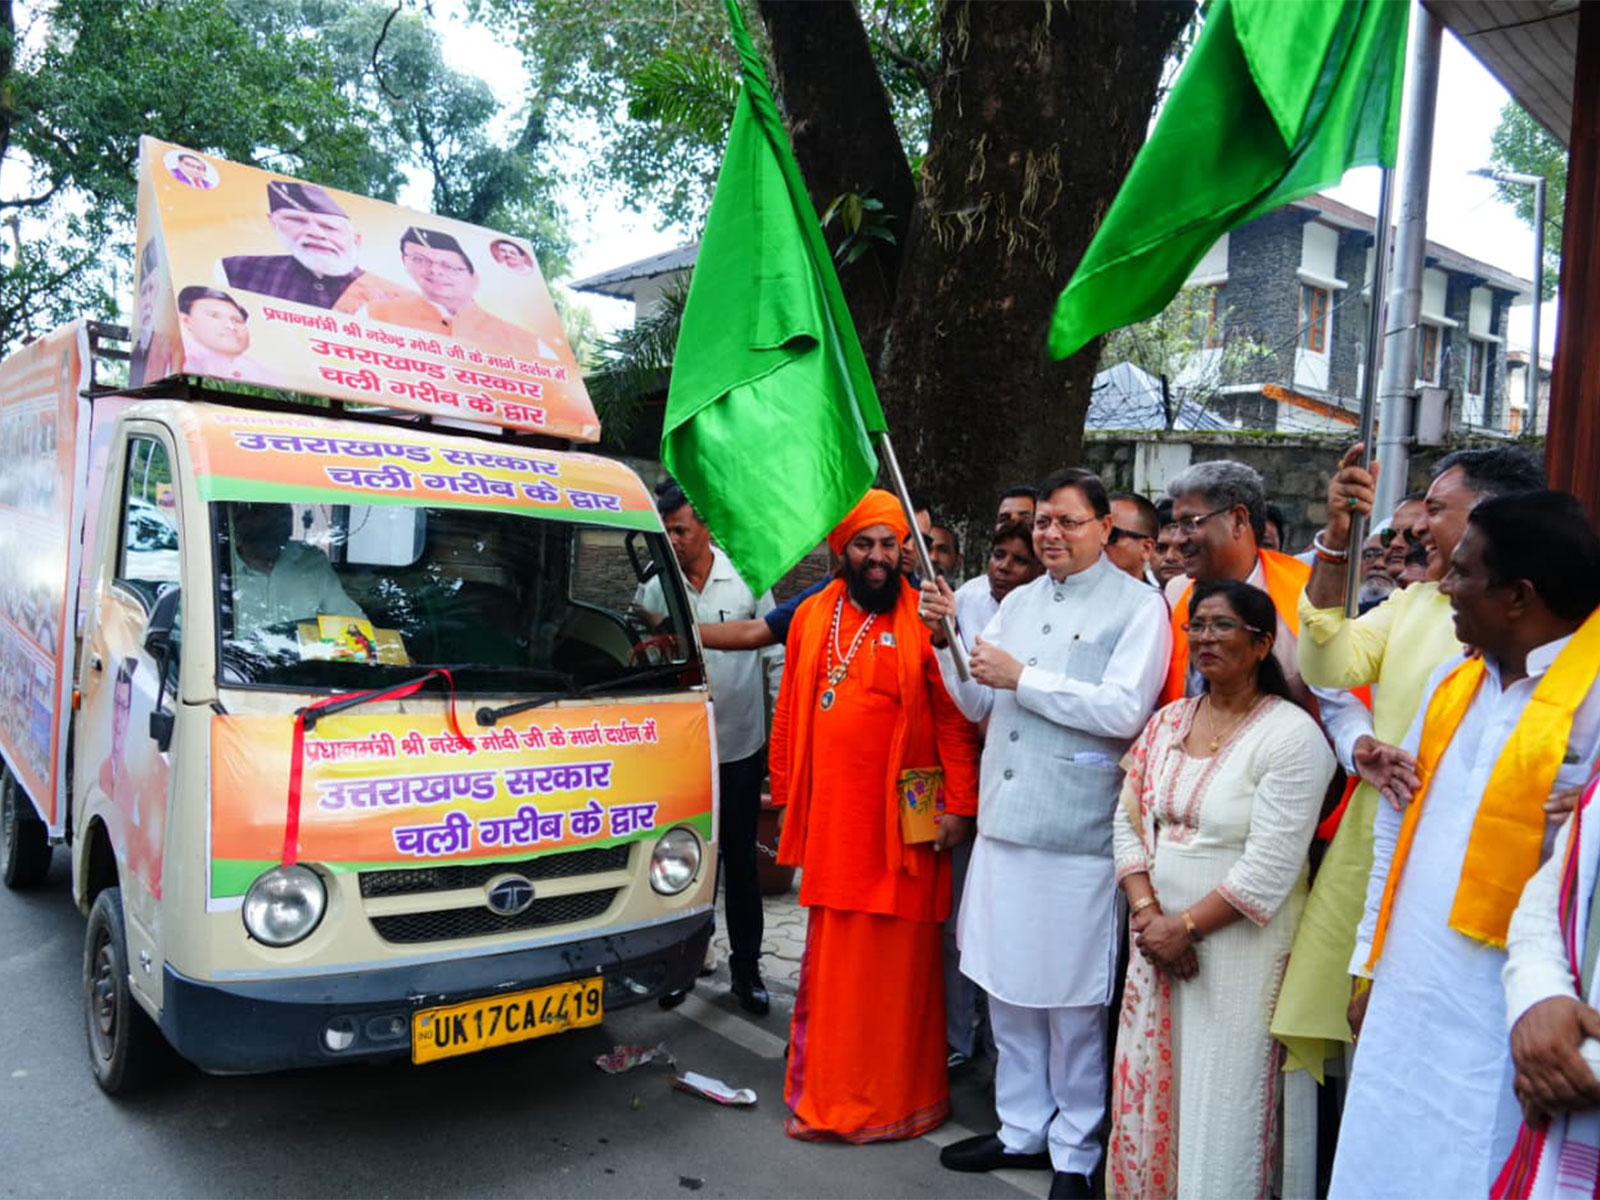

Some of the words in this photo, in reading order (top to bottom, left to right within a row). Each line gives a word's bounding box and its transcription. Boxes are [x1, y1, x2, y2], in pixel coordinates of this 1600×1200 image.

[263, 306, 338, 333] प्रधानमंत्री
[343, 322, 362, 338] श्री
[366, 328, 406, 349] नरेन्द्र
[410, 337, 442, 356] मोदी
[445, 345, 465, 361] जी
[469, 350, 483, 364] के
[487, 355, 516, 371] मार्ग
[519, 361, 552, 380] दर्शन
[554, 368, 566, 381] में
[309, 337, 446, 379] उत्तराखण्ड
[452, 367, 542, 398] सरकार
[319, 366, 381, 392] चली
[466, 393, 495, 414] के
[500, 401, 545, 424] द्वार
[235, 432, 432, 463] उत्तराखण्ड
[439, 448, 559, 476] सरकार
[327, 464, 412, 489] चली
[522, 480, 559, 503] के
[566, 488, 621, 512] द्वार
[305, 731, 397, 762] प्रधानमंत्री
[401, 731, 425, 756] श्री
[479, 728, 520, 751] मोदी
[521, 726, 546, 749] जी
[547, 726, 567, 747] के
[569, 723, 603, 745] मार्ग
[604, 720, 642, 743] दर्शन
[643, 720, 658, 742] में
[318, 770, 498, 810] उत्तराखण्ड
[505, 762, 613, 795] सरकार
[395, 812, 472, 854] चली
[479, 805, 565, 845] गरीब
[570, 800, 604, 836] के
[609, 803, 658, 836] द्वार
[434, 988, 600, 1048] UK17CA4419
